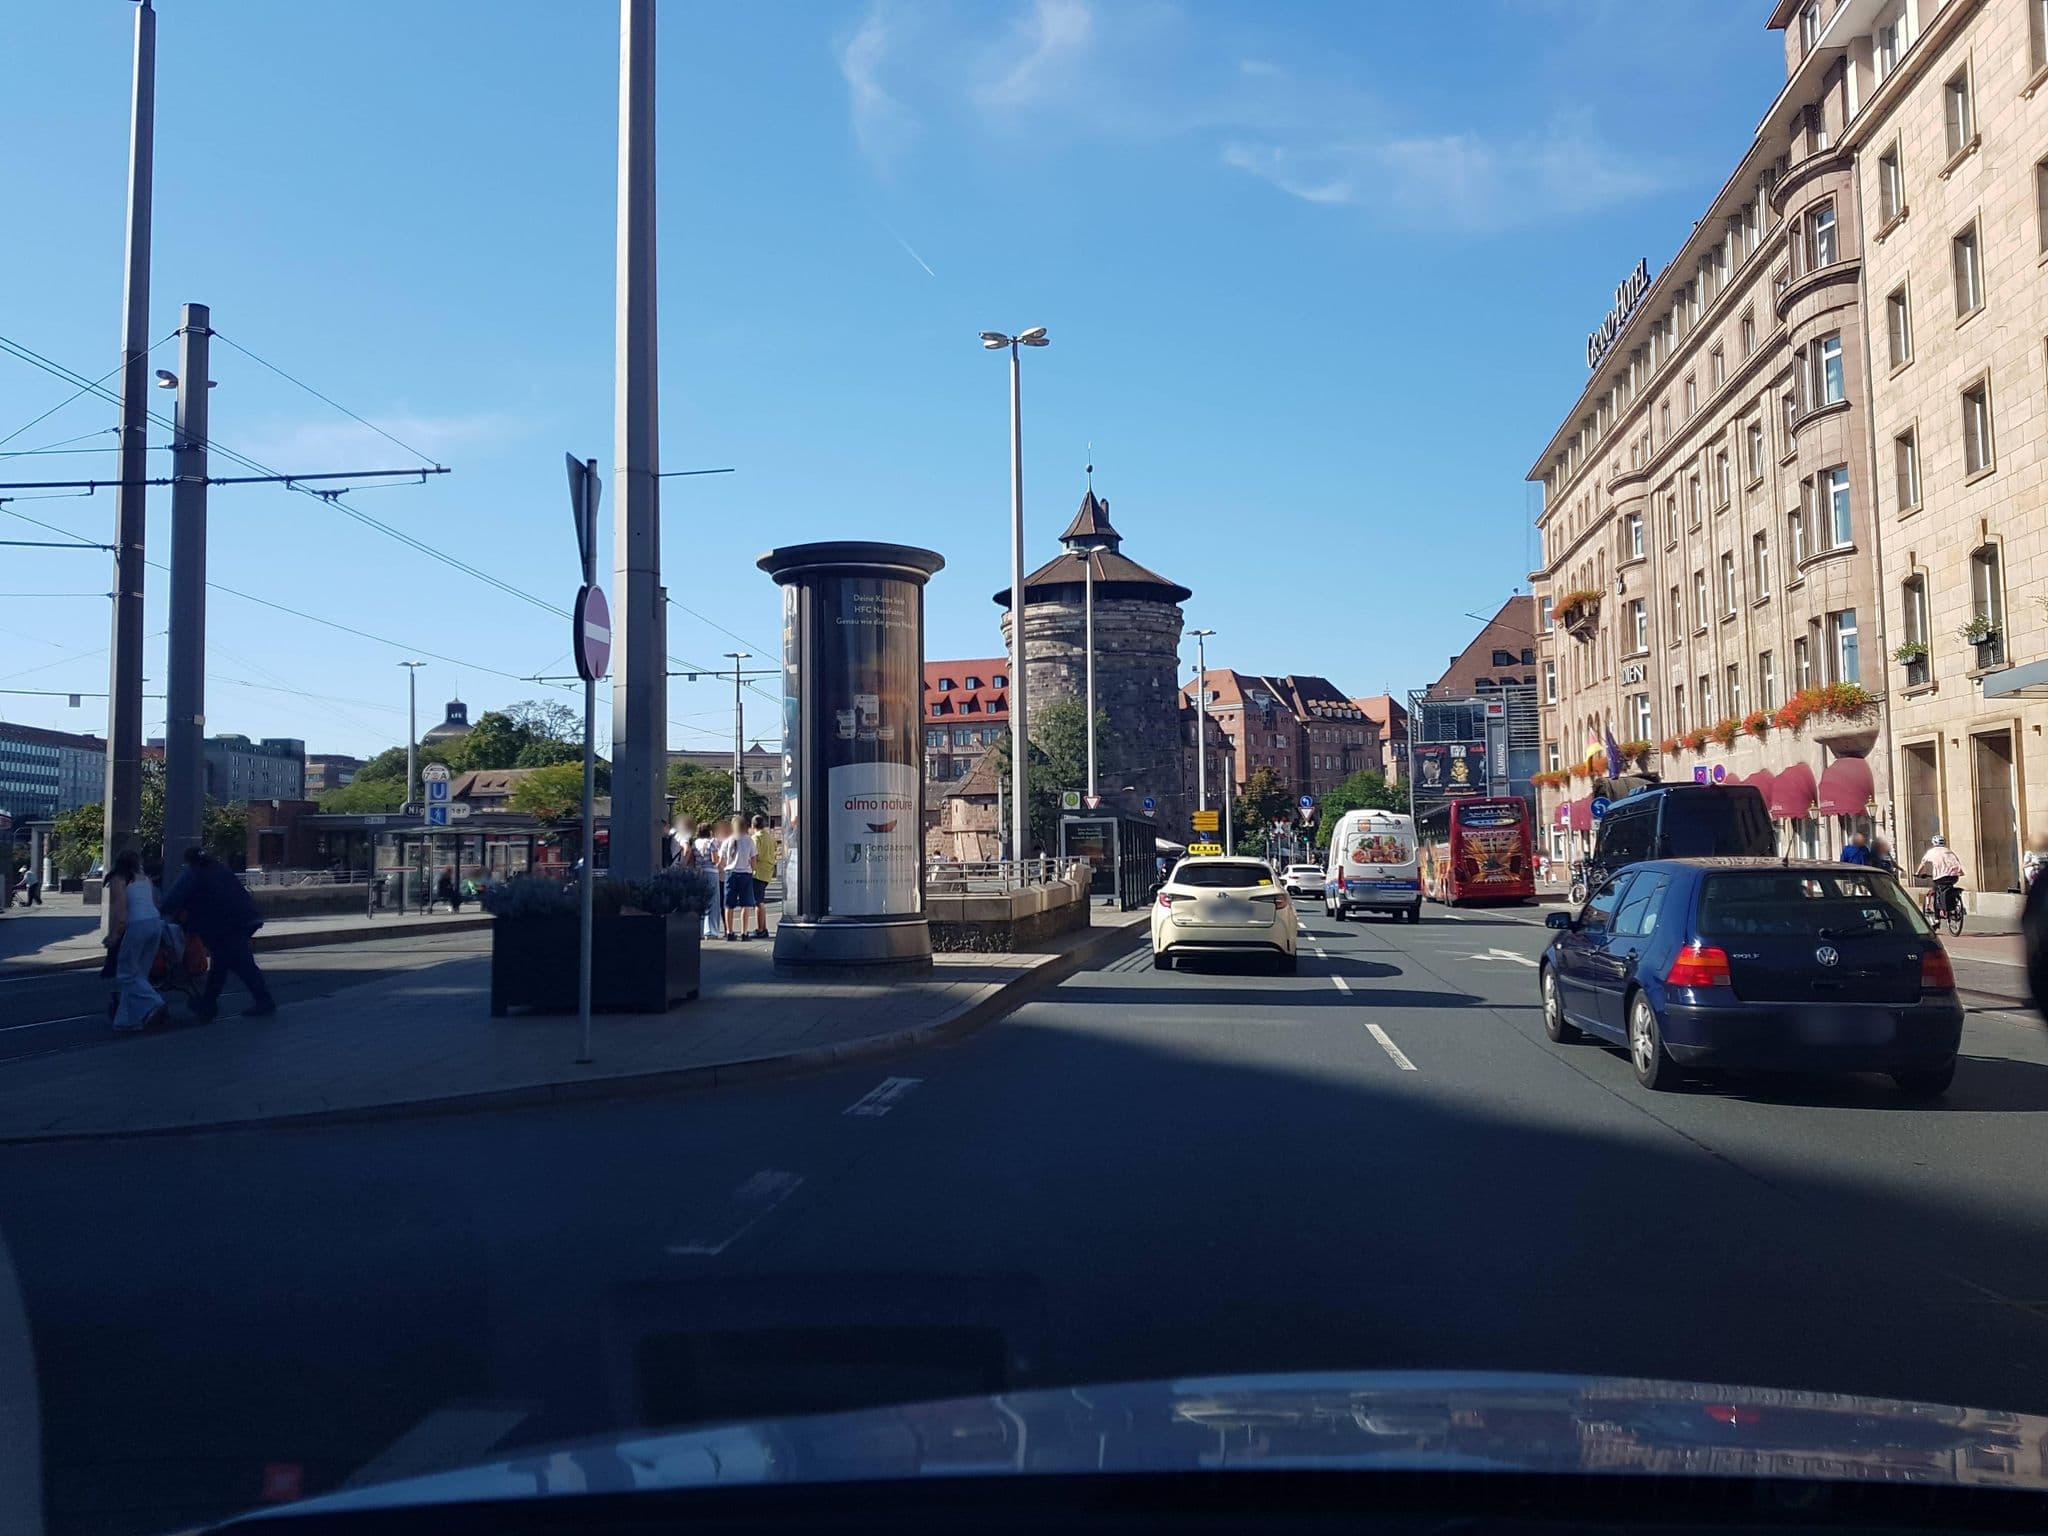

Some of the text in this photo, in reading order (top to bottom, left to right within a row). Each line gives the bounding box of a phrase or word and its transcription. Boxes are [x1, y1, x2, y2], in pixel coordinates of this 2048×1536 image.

[432, 783, 446, 799] U
[844, 797, 913, 811] almo nature
